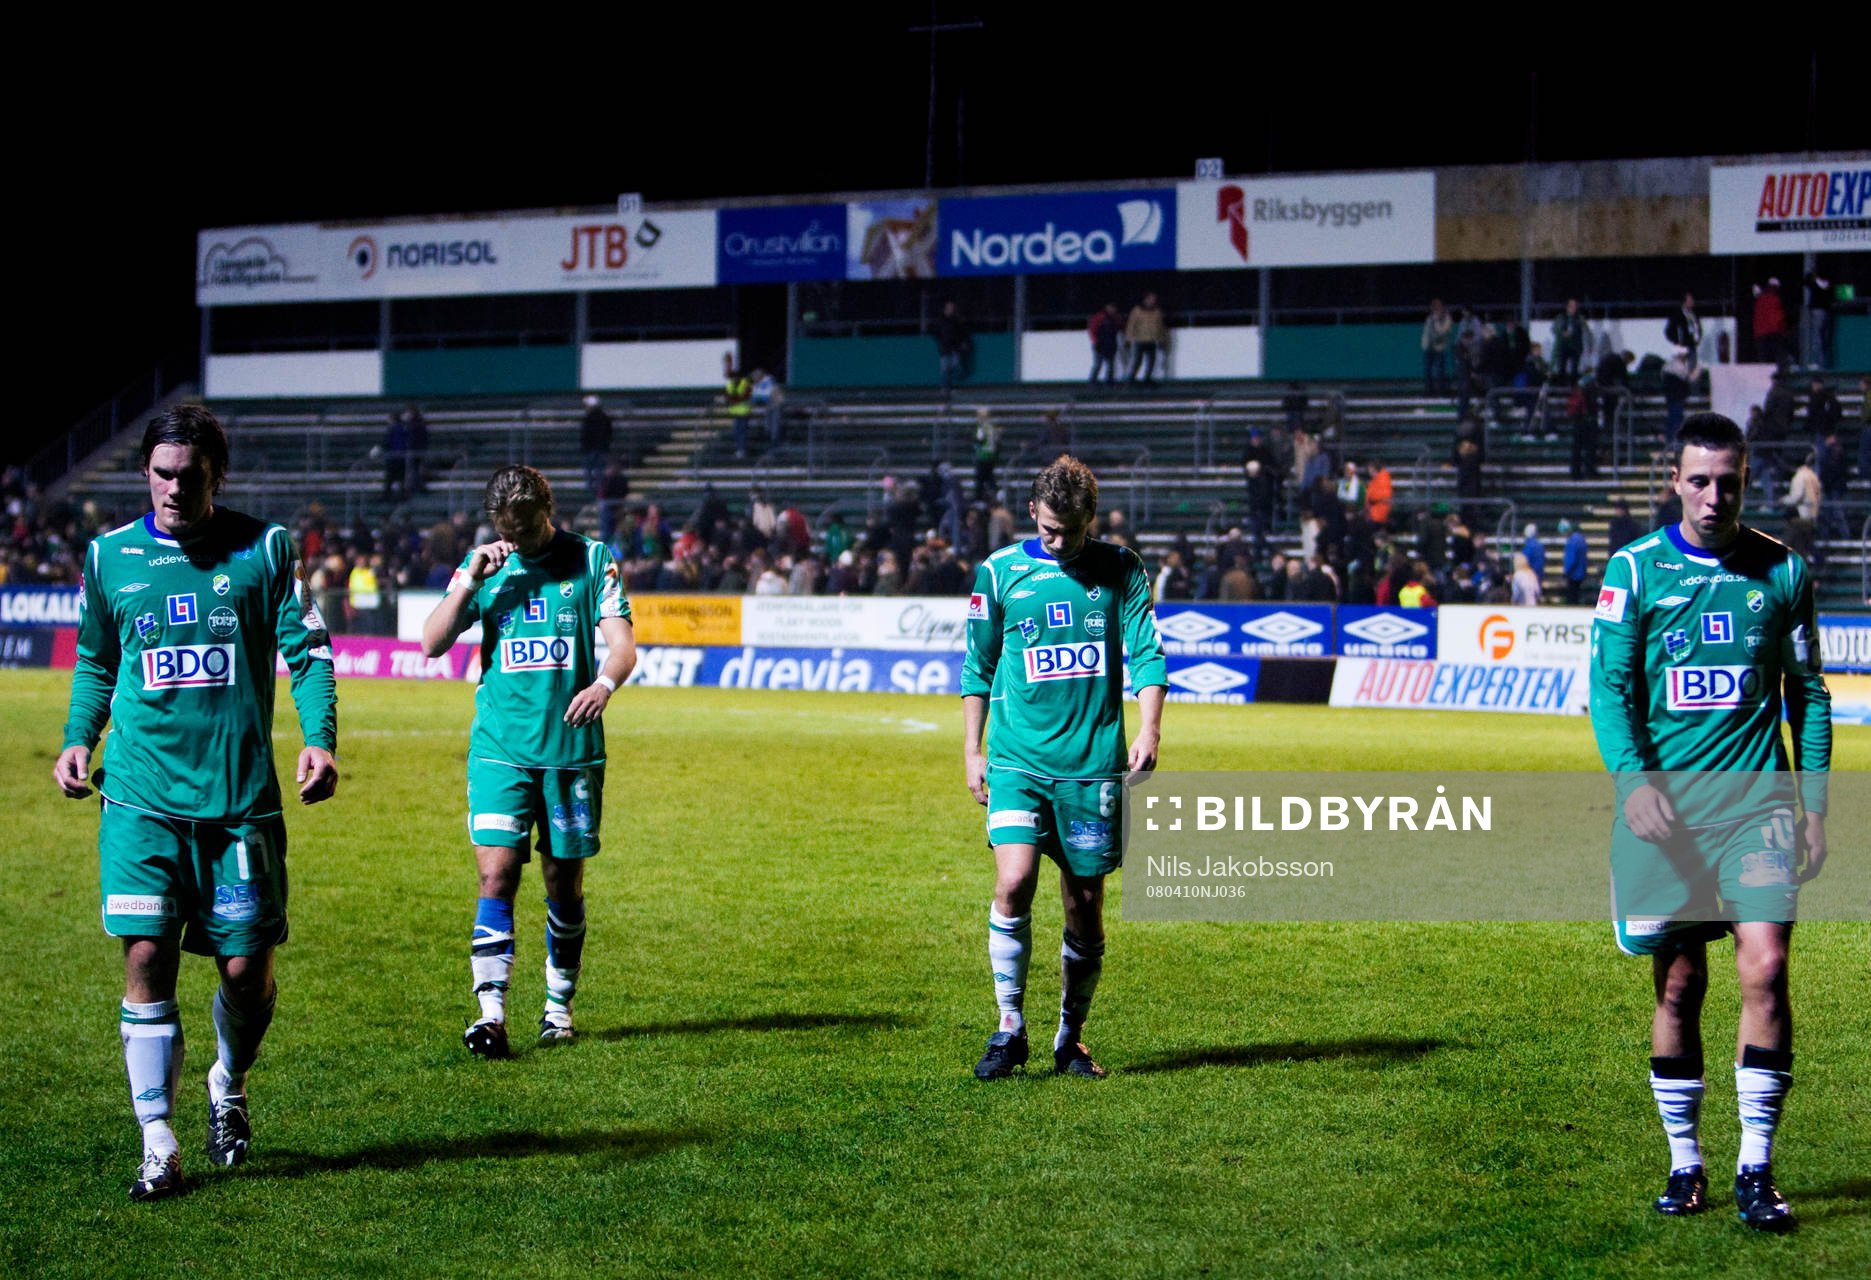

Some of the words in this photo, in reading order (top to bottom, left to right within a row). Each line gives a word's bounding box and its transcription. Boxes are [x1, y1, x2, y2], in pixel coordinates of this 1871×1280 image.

[1253, 197, 1392, 227] Riksbyggen
[387, 240, 497, 268] NORISOL
[561, 225, 628, 271] JTB
[951, 221, 1115, 267] Nordea
[1526, 623, 1591, 645] FYRS
[156, 647, 229, 680] BDO
[511, 638, 569, 664] BDO
[1036, 644, 1100, 673] BDO
[1356, 660, 1575, 709] AUTOEXPERTEN
[1683, 668, 1759, 699] BDO
